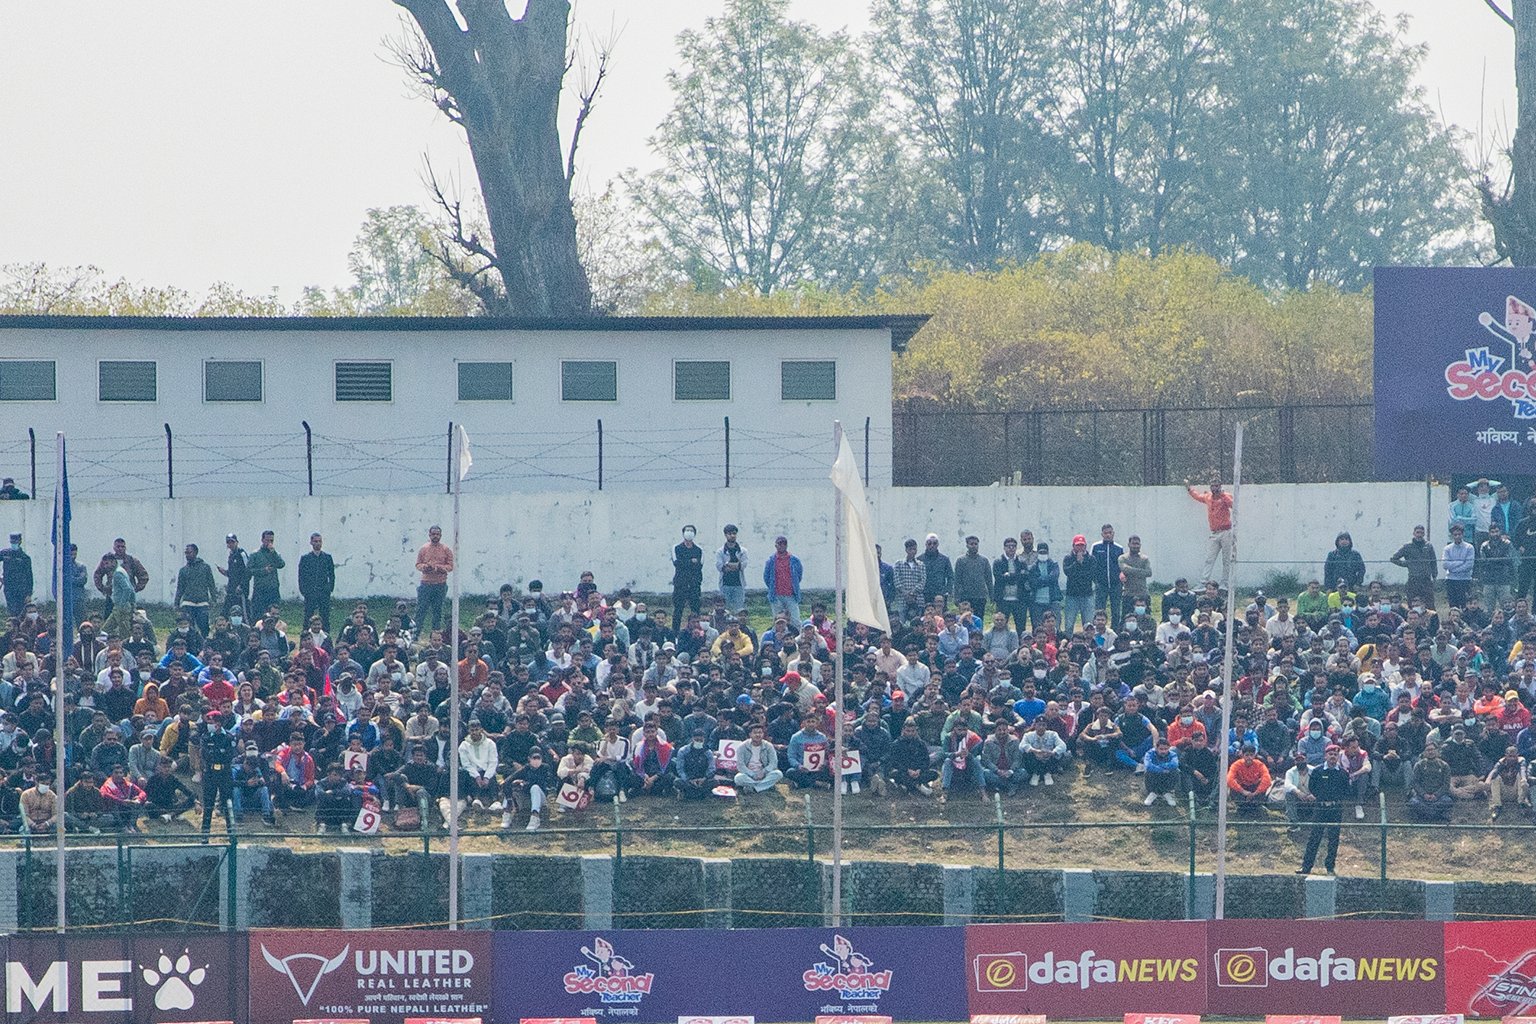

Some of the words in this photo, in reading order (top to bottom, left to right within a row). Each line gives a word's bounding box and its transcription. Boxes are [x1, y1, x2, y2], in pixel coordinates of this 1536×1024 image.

[1468, 350, 1502, 373] My
[724, 742, 736, 759] 6
[808, 754, 821, 770] 9
[362, 813, 375, 831] 9
[355, 949, 474, 975] UNITED
[816, 963, 833, 975] My
[576, 966, 593, 979] My
[803, 970, 893, 991] Second
[6, 960, 132, 1013] ME
[357, 977, 396, 989] REAL
[404, 977, 473, 989] LEATHER
[563, 973, 654, 994] Second
[601, 992, 642, 1002] Teacher
[840, 989, 881, 1000] Teacher
[357, 1005, 386, 1014] PURE
[391, 1005, 429, 1013] NEPALI
